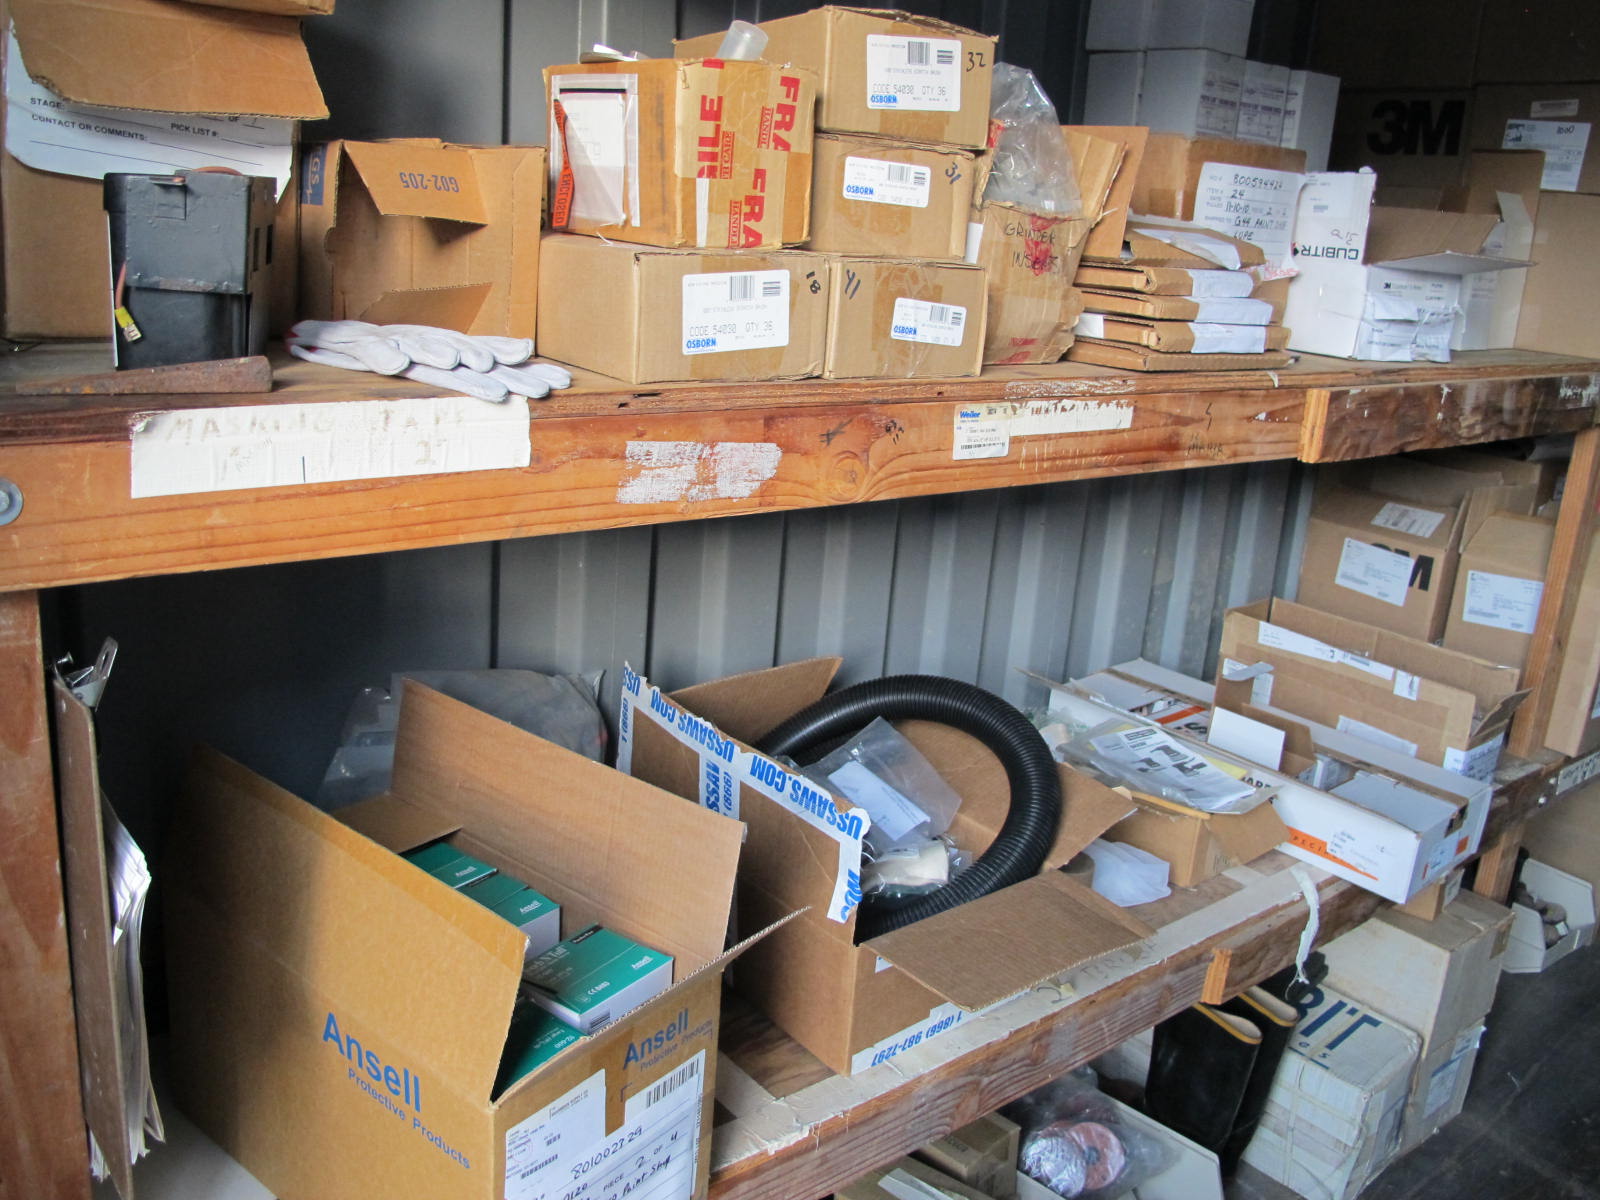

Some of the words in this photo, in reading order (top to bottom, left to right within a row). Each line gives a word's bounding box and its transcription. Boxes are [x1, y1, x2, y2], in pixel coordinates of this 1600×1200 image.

[966, 51, 986, 72] 32
[30, 97, 65, 110] STAGE:
[870, 94, 898, 104] OSBORN
[31, 113, 76, 129] CONTACT
[78, 122, 92, 131] OR
[94, 124, 148, 141] COMMENTS:
[171, 123, 191, 133] PICK
[192, 127, 211, 137] LIST
[1367, 99, 1466, 156] 3M
[399, 171, 460, 193] G02-205
[846, 184, 874, 195] OSBORN
[893, 325, 917, 336] OSBORN
[686, 338, 717, 349] OSBORN
[750, 754, 863, 840] USSAWS.COM
[925, 1015, 955, 1039] (866)
[622, 1007, 689, 1070] Ansell
[322, 1012, 421, 1113] Ansell
[641, 1043, 679, 1072] Protective
[348, 1067, 406, 1120] Protective
[412, 1116, 470, 1169] Products
[603, 1172, 624, 1192] PIECE
